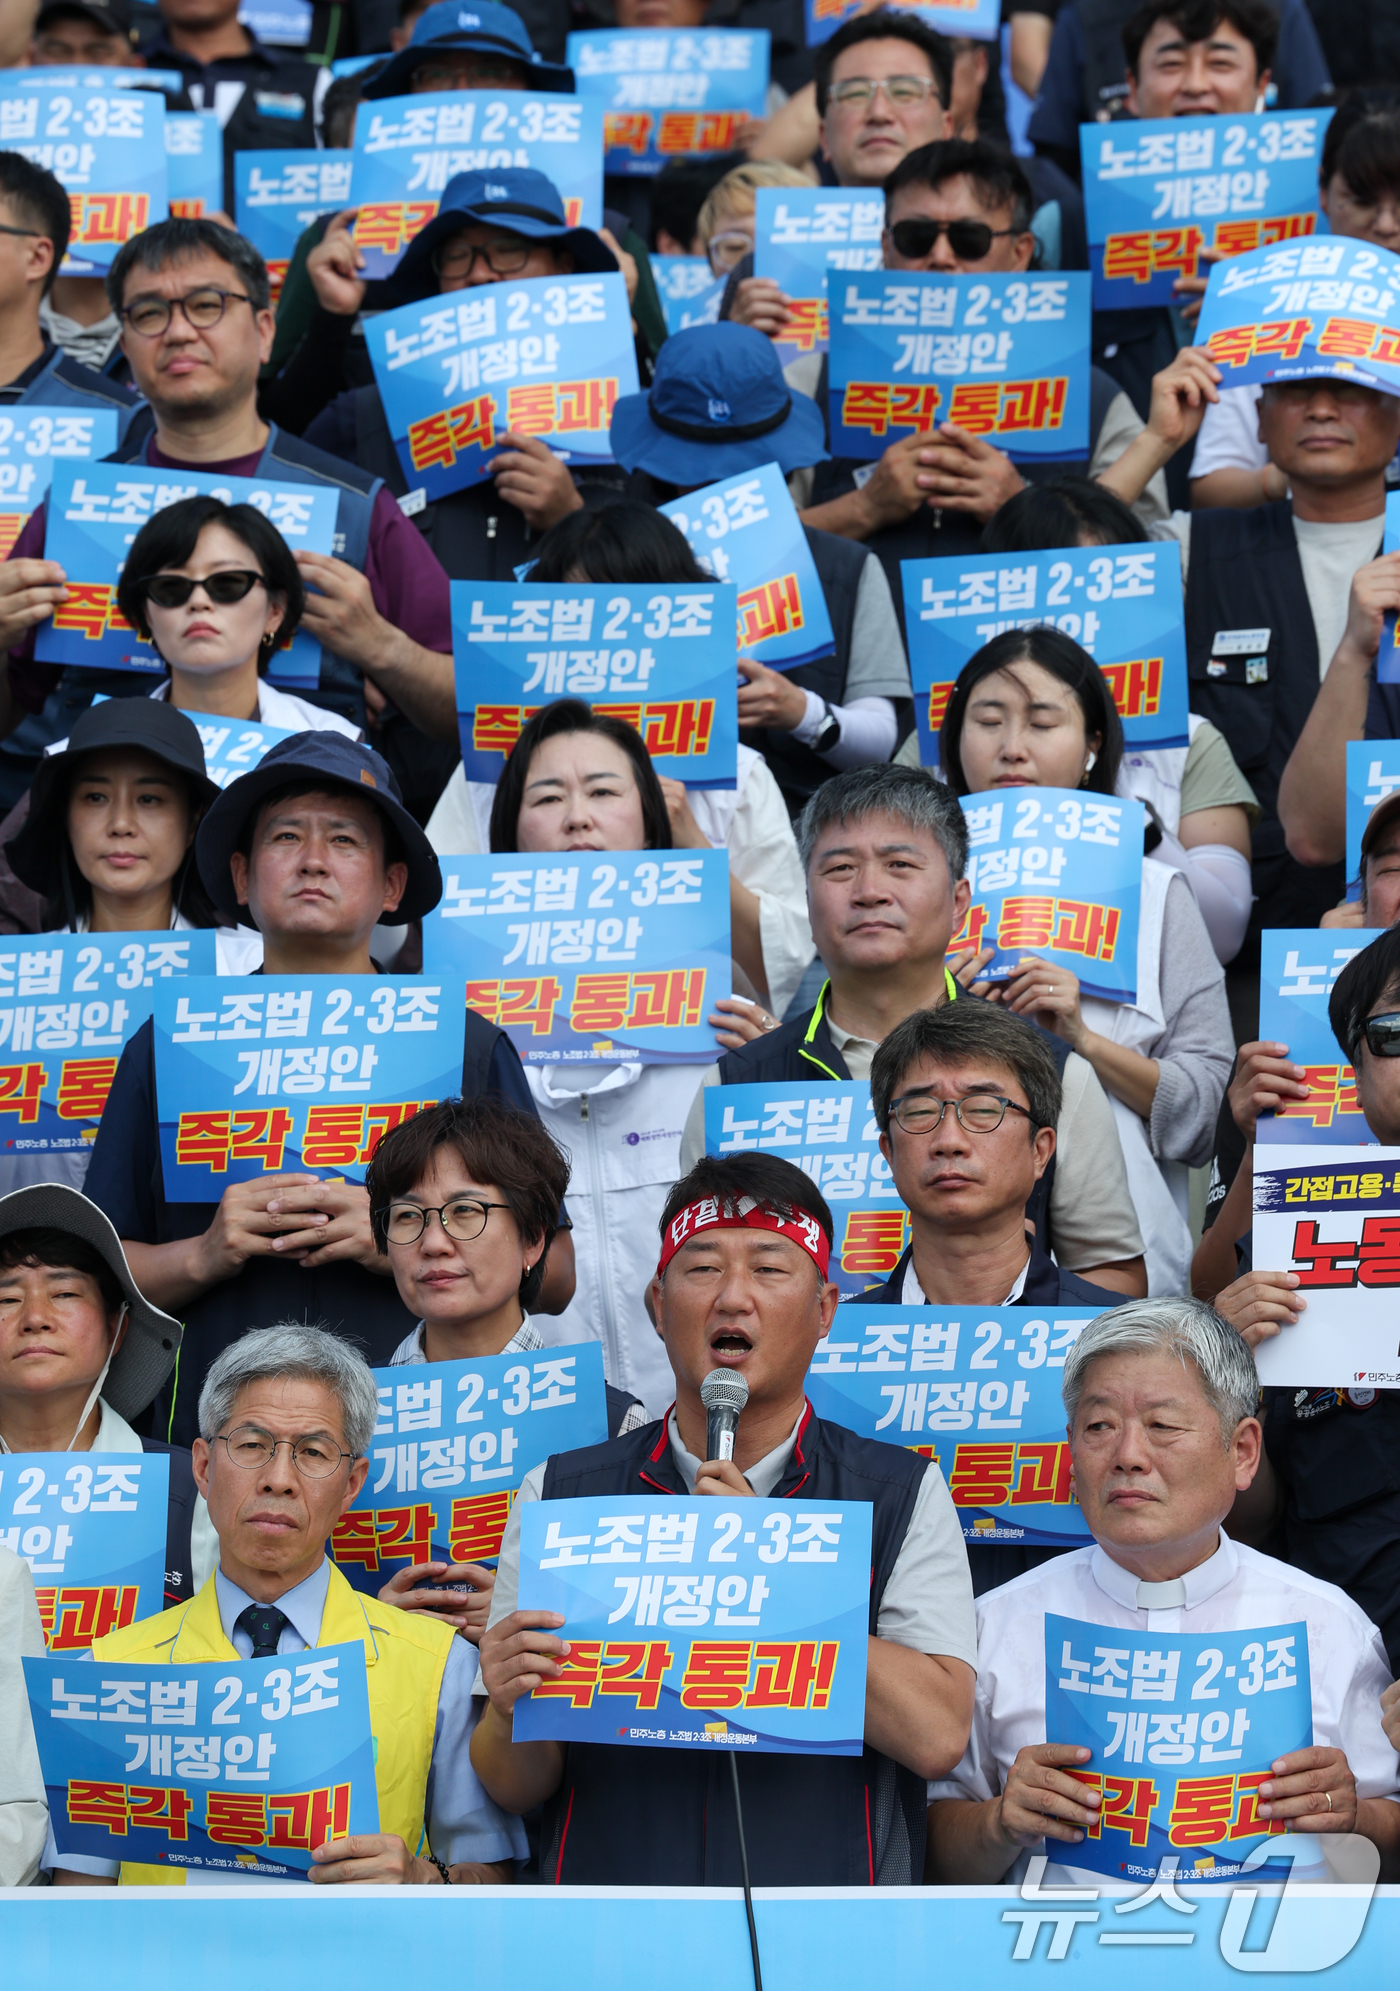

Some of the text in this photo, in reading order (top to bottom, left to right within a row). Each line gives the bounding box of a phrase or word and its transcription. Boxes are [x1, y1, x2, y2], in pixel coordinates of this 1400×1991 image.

[46, 96, 145, 138] 2·3조
[364, 102, 582, 154] 노조법 2·3조
[1097, 118, 1317, 180] 노조법 2·3조
[1152, 169, 1269, 220] 개정안
[1102, 225, 1203, 284] 즉각
[1217, 245, 1346, 298] 노조법
[842, 280, 1069, 327] 노조법 2·3조
[1262, 280, 1397, 318] 개정안
[385, 282, 605, 372] 노조법 2·3조
[893, 331, 1013, 375] 개정안
[1206, 317, 1314, 368] 즉각
[441, 333, 560, 398] 개정안
[408, 392, 497, 472] 즉각
[842, 376, 1069, 436] 즉각 통과!
[920, 552, 1156, 621] 노조법 2·3조
[467, 593, 714, 643] 노조법 2·3조
[523, 648, 655, 694] 개정안
[1012, 799, 1122, 847] 2·3조
[441, 859, 704, 918] 노조법 2·3조
[502, 916, 643, 966] 개정안
[997, 895, 1121, 962] 통과!
[73, 941, 190, 993] 2·3조
[172, 986, 442, 1043] 노조법 2·3조
[570, 967, 707, 1034] 통과!
[233, 1044, 379, 1096] 개정안
[175, 1107, 294, 1173] 즉각
[719, 1097, 852, 1152] 노조법
[671, 1195, 720, 1247] 단결
[810, 1322, 960, 1373] 노조법
[456, 1356, 577, 1424] 2·3조
[875, 1380, 1030, 1431] 개정안
[373, 1427, 518, 1494] 개정안
[12, 1465, 142, 1515] 2·3조
[330, 1503, 438, 1572] 즉각
[539, 1513, 699, 1570] 노조법
[708, 1512, 843, 1563] 2·3조
[982, 1528, 1026, 1538] 개정운동본부
[607, 1575, 770, 1626] 개정안
[51, 1657, 339, 1726] 노조법 2·3조
[530, 1640, 840, 1710] 즉각 통과!
[1058, 1635, 1297, 1701] 노조법 2·3조
[125, 1732, 276, 1781] 개정안
[630, 1728, 666, 1739] 민주노총
[669, 1730, 692, 1741] 노조법
[713, 1733, 758, 1744] 개정운동본부
[1103, 1707, 1250, 1765] 개정안
[67, 1778, 351, 1852] 즉각 통과!
[168, 1853, 202, 1864] 민주노총
[205, 1857, 227, 1867] 노조법
[247, 1862, 287, 1874] 개정운동본부
[1127, 1864, 1157, 1878] 민주노총
[1202, 1864, 1240, 1878] 개정운동본부
